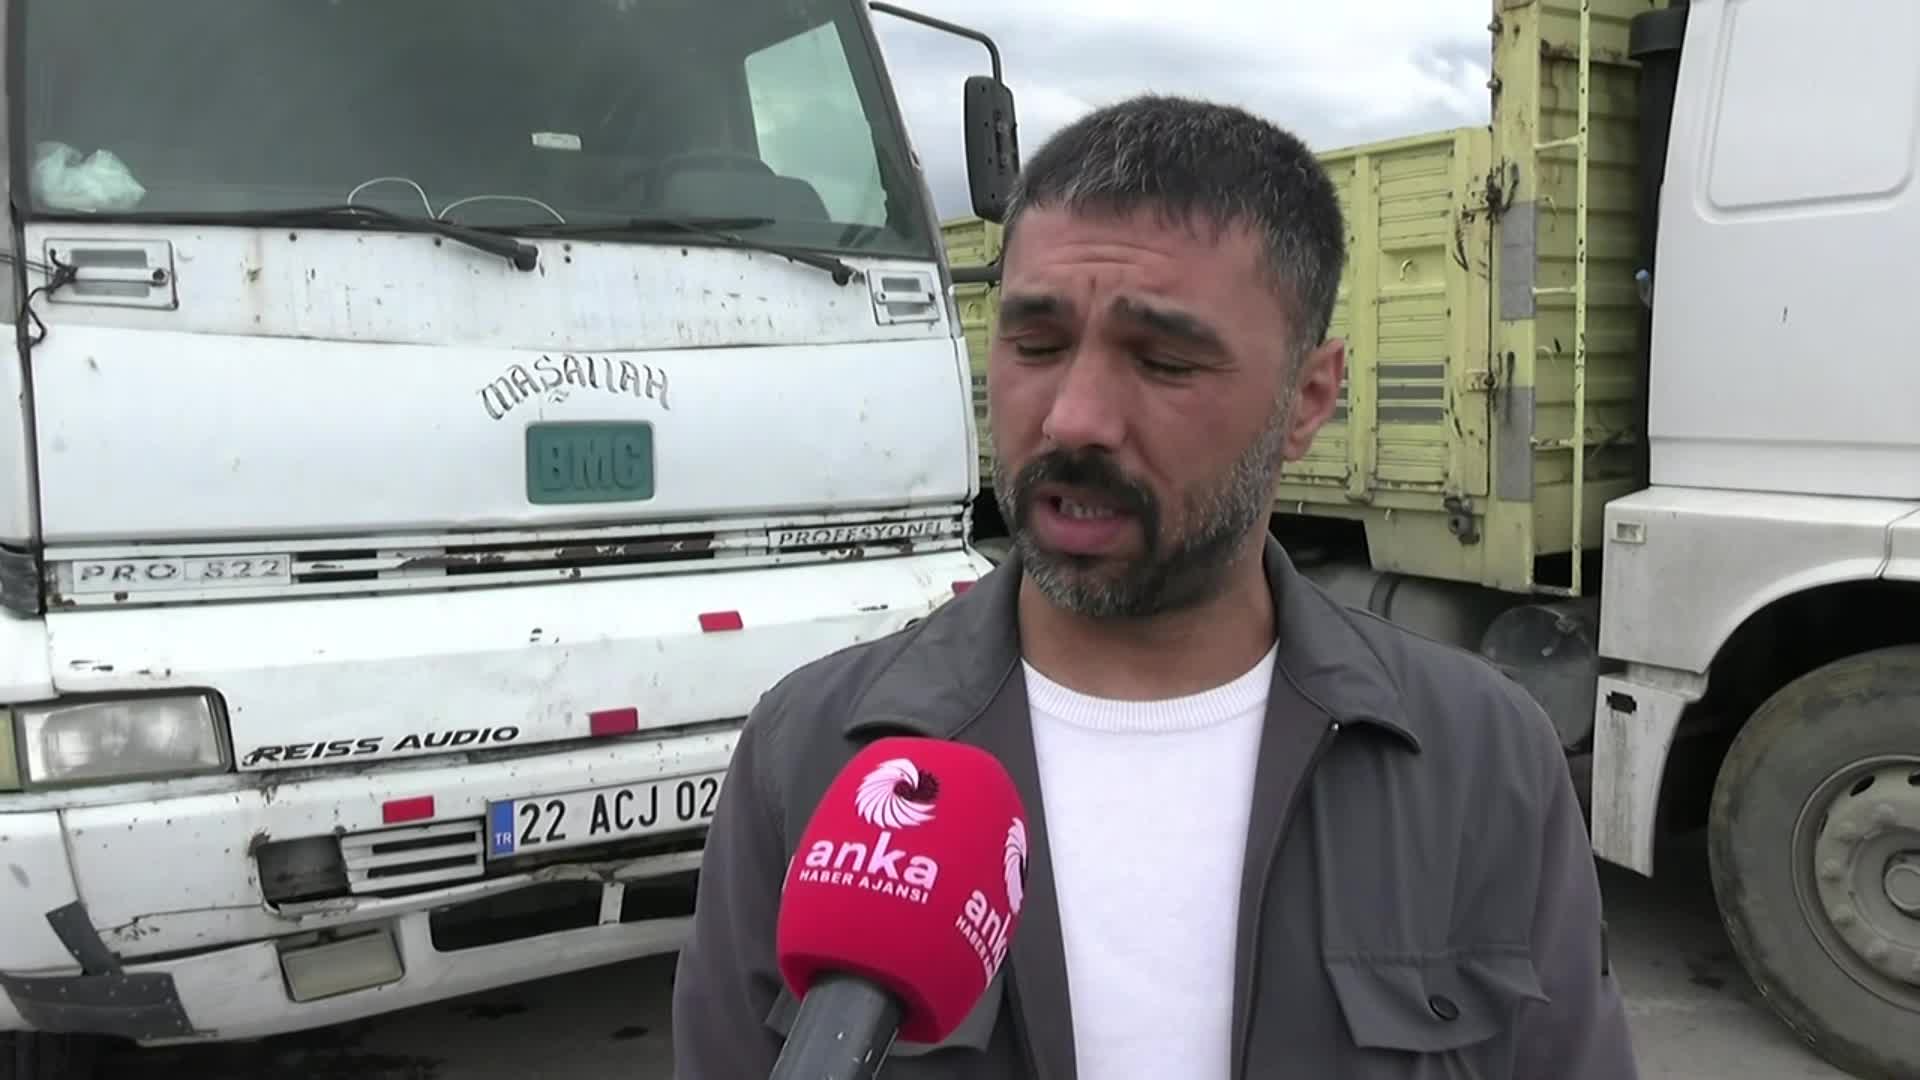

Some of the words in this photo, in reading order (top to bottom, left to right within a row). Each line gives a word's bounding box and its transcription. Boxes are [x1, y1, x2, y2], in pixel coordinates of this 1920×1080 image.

[538, 434, 642, 492] BMC
[779, 518, 943, 546] PROFESYONEL
[80, 563, 178, 583] PRO
[204, 558, 282, 579] 522
[243, 736, 384, 767] REISS
[393, 726, 520, 752] AUDIO
[519, 799, 567, 846] 22
[589, 785, 658, 835] ACJ
[676, 777, 718, 821] 02
[495, 833, 512, 846] TR
[805, 831, 939, 889] anka
[799, 869, 853, 886] HABER
[858, 873, 928, 904] AJANSI
